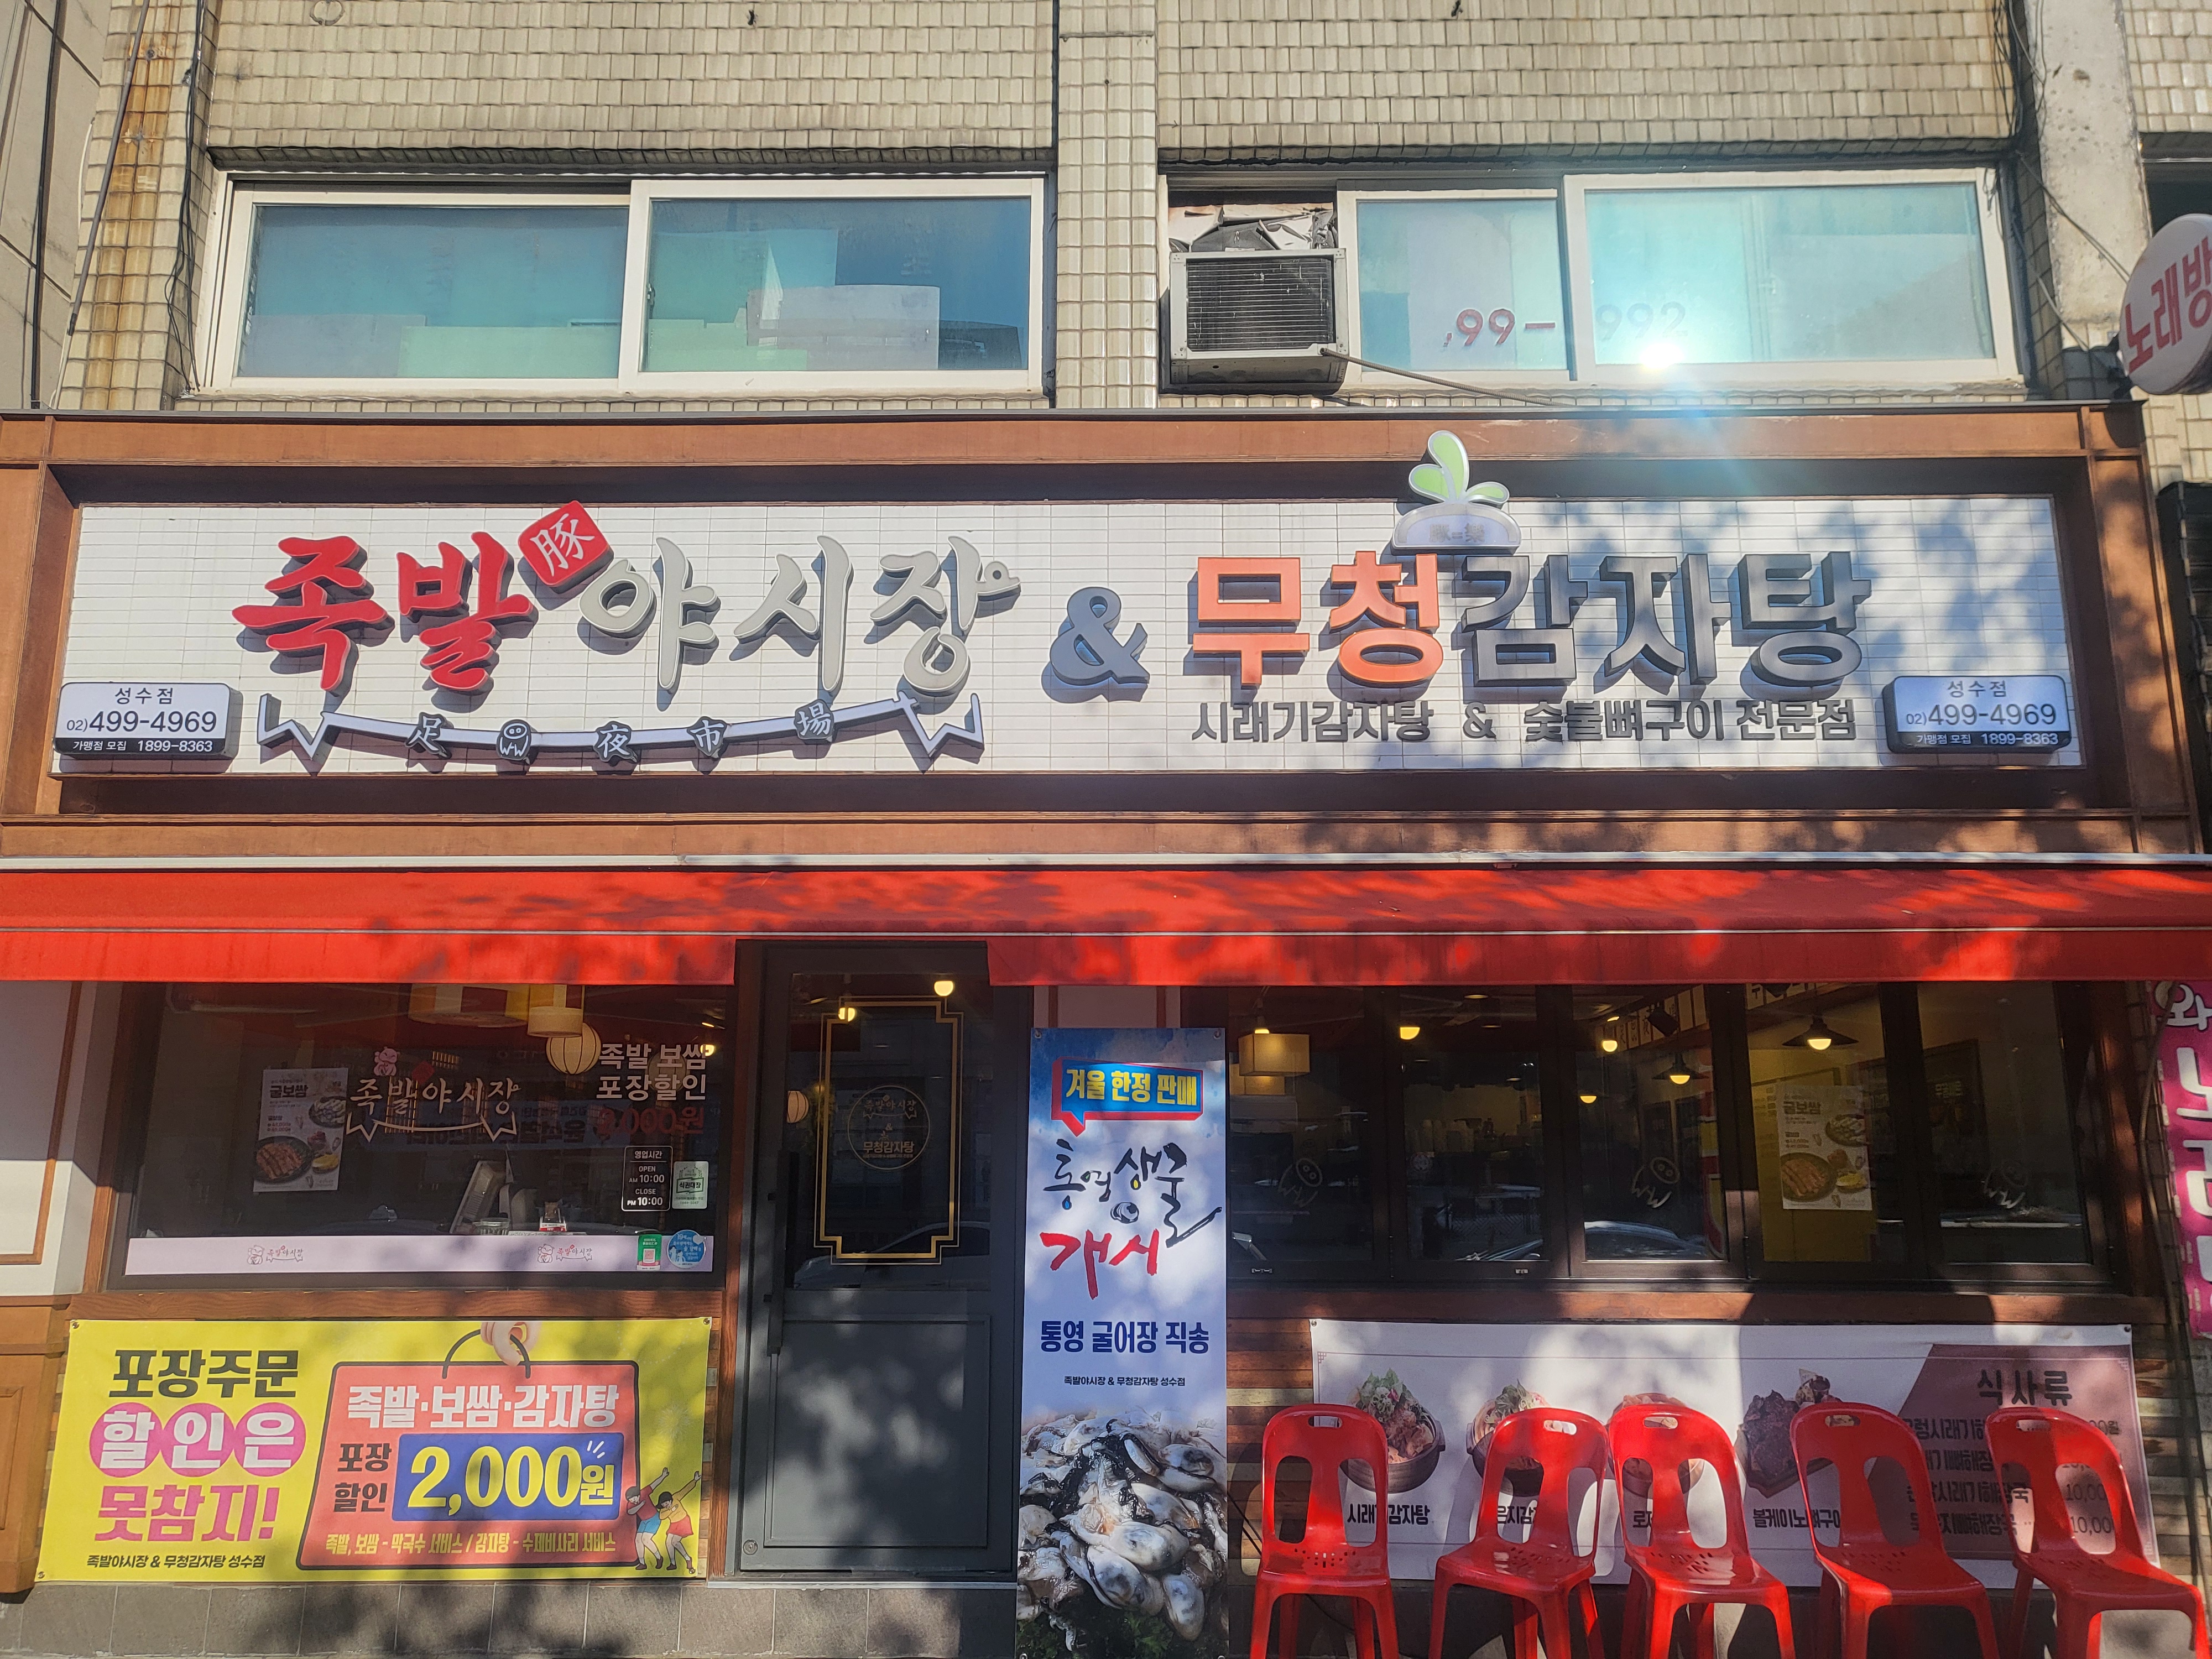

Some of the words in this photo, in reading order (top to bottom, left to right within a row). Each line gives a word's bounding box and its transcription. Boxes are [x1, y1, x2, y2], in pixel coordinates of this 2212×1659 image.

[2125, 236, 2212, 374] 노래방
[1444, 309, 1556, 347] 99-
[529, 512, 596, 576] 豚
[1049, 587, 1151, 686] &
[114, 687, 174, 705] 성수점
[1947, 680, 2007, 697] 성수점
[66, 710, 217, 733] 02)499-4969
[1192, 701, 1434, 742] 시래기감자탕
[1463, 703, 1498, 739] &
[1524, 700, 1724, 741] 숯불뼈구이
[1736, 700, 1856, 740] 전문점
[1906, 703, 2057, 726] 02)499-4969
[72, 740, 104, 751] 가맹점
[106, 740, 127, 751] 모집
[137, 740, 213, 752] 1899-8363
[1917, 734, 1948, 745] 가맹점
[1950, 734, 1972, 745] 모집
[1981, 733, 2059, 745] 1899-8363
[599, 1043, 651, 1070] 족발
[656, 1044, 706, 1070] 보쌈
[349, 1078, 522, 1115] 족발야시장
[1066, 1068, 1106, 1100] 겨울
[1110, 1070, 1151, 1103] 한정
[1156, 1073, 1197, 1107] 판매
[634, 1151, 663, 1160] 영업시간
[863, 1140, 915, 1154] 무청감자탕
[639, 1175, 665, 1183] 10:00
[637, 1197, 663, 1206] 10:00
[1039, 1229, 1159, 1300] 개시
[1040, 1320, 1084, 1353] 통영
[1092, 1321, 1158, 1354] 굴어장
[1165, 1322, 1209, 1354] 직송
[108, 1349, 299, 1398] 포장주문
[1064, 1376, 1106, 1385] 족발야시장
[1107, 1377, 1115, 1386] &
[1116, 1376, 1159, 1386] 무청감자탕
[1160, 1377, 1186, 1386] 성수점
[1977, 1369, 2073, 1406] 식사류
[100, 1411, 295, 1469] 할인은
[337, 1442, 393, 1473] 포장
[406, 1446, 615, 1516] 2,000원
[95, 1484, 280, 1542] 못참지!
[334, 1482, 387, 1513] 할인
[1347, 1503, 1431, 1525] 시래감자탕
[354, 1534, 379, 1554] 보쌈
[391, 1533, 426, 1554] 막국수
[428, 1533, 463, 1553] 서비스
[476, 1533, 510, 1553] 감자탕
[522, 1532, 579, 1553] 수제비사리
[582, 1532, 616, 1552] 서비스
[87, 1554, 149, 1568] 족발야시장
[150, 1556, 161, 1568] &
[164, 1555, 226, 1568] 무청감자탕
[228, 1555, 265, 1568] 성수점
